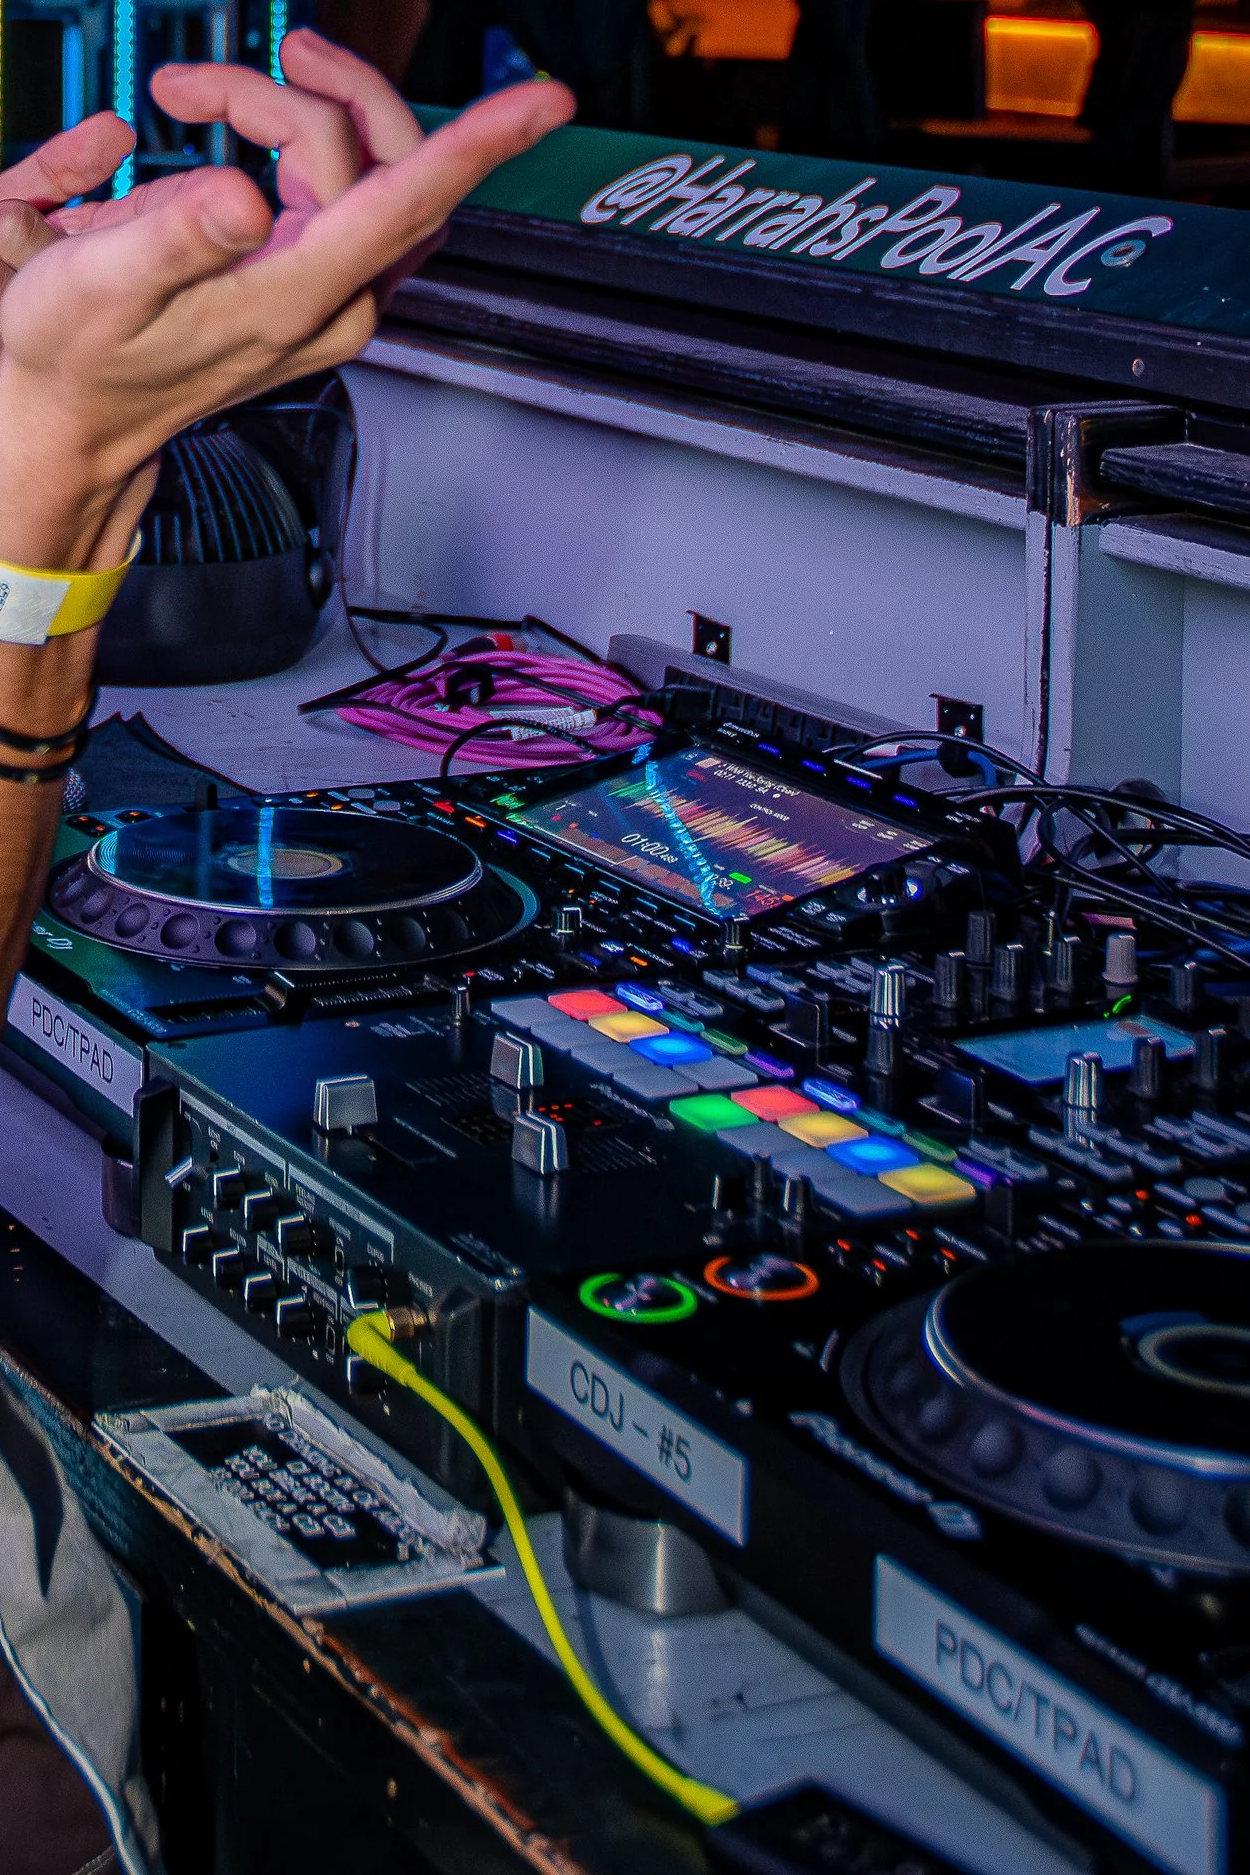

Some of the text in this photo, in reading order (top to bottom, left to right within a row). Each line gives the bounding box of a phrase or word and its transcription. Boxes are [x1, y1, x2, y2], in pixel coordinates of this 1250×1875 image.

[579, 153, 1175, 297] @HarrahsPoolAC
[32, 997, 114, 1084] PDC/TPAD
[570, 1361, 624, 1433] CDJ
[657, 1424, 693, 1485] #5
[935, 1621, 1140, 1803] PDC/TPAD
